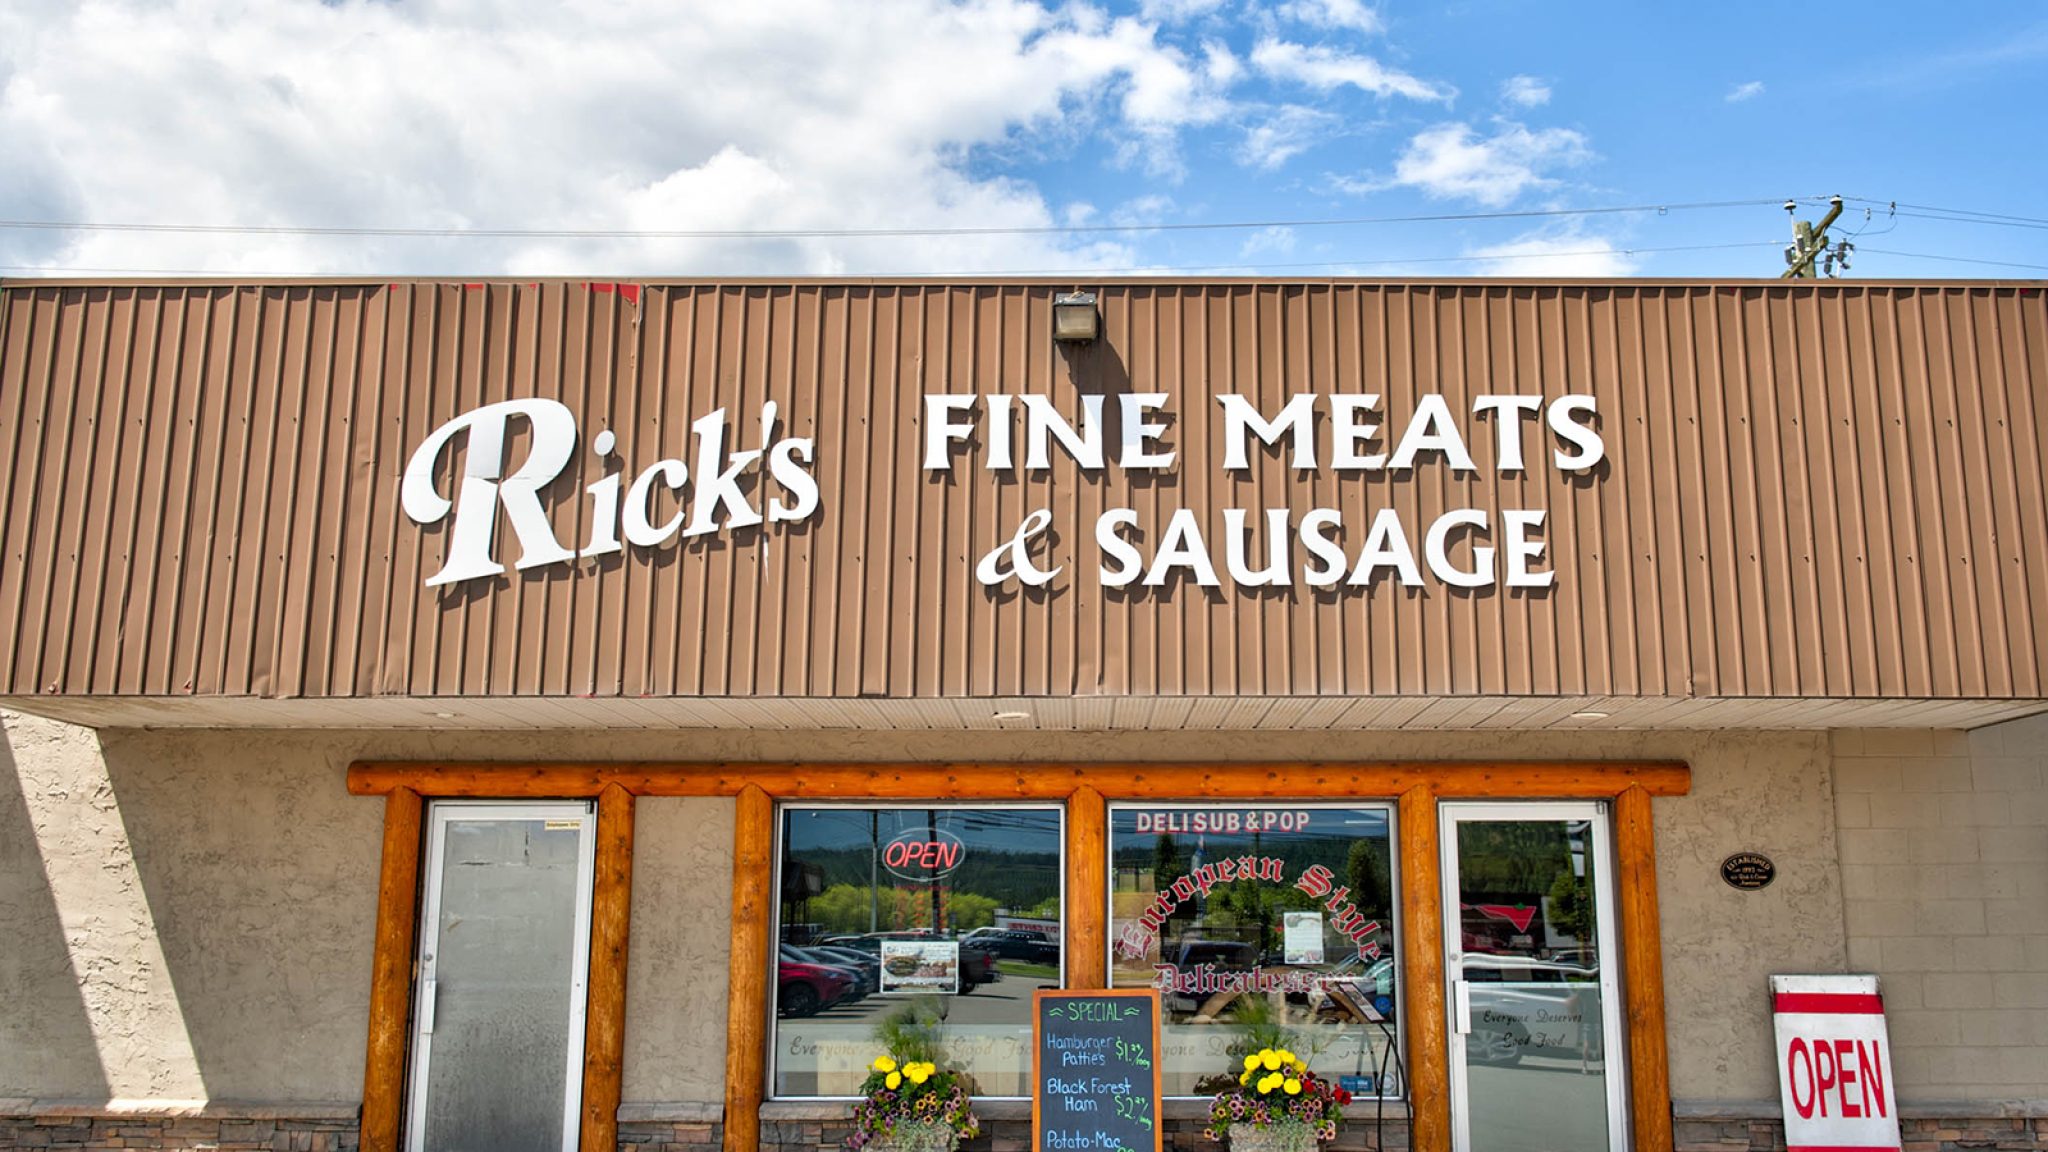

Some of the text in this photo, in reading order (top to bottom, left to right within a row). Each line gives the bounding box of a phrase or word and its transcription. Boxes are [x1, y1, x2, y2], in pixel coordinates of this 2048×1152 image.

[923, 393, 1605, 471] FINE MEATS
[401, 397, 818, 586] Rick's
[976, 508, 1555, 587] & SAUSAGE
[885, 841, 958, 868] OPEN
[1115, 855, 1382, 962] European Style
[1068, 1002, 1123, 1021] SPECIAL
[1483, 1008, 1582, 1026] Everyone Deserves
[1046, 1033, 1114, 1051] Hamburger
[1503, 1032, 1566, 1048] Good Food
[1047, 1077, 1132, 1095] Black Forest
[1787, 1037, 1888, 1120] OPEN
[1065, 1096, 1098, 1112] Ham
